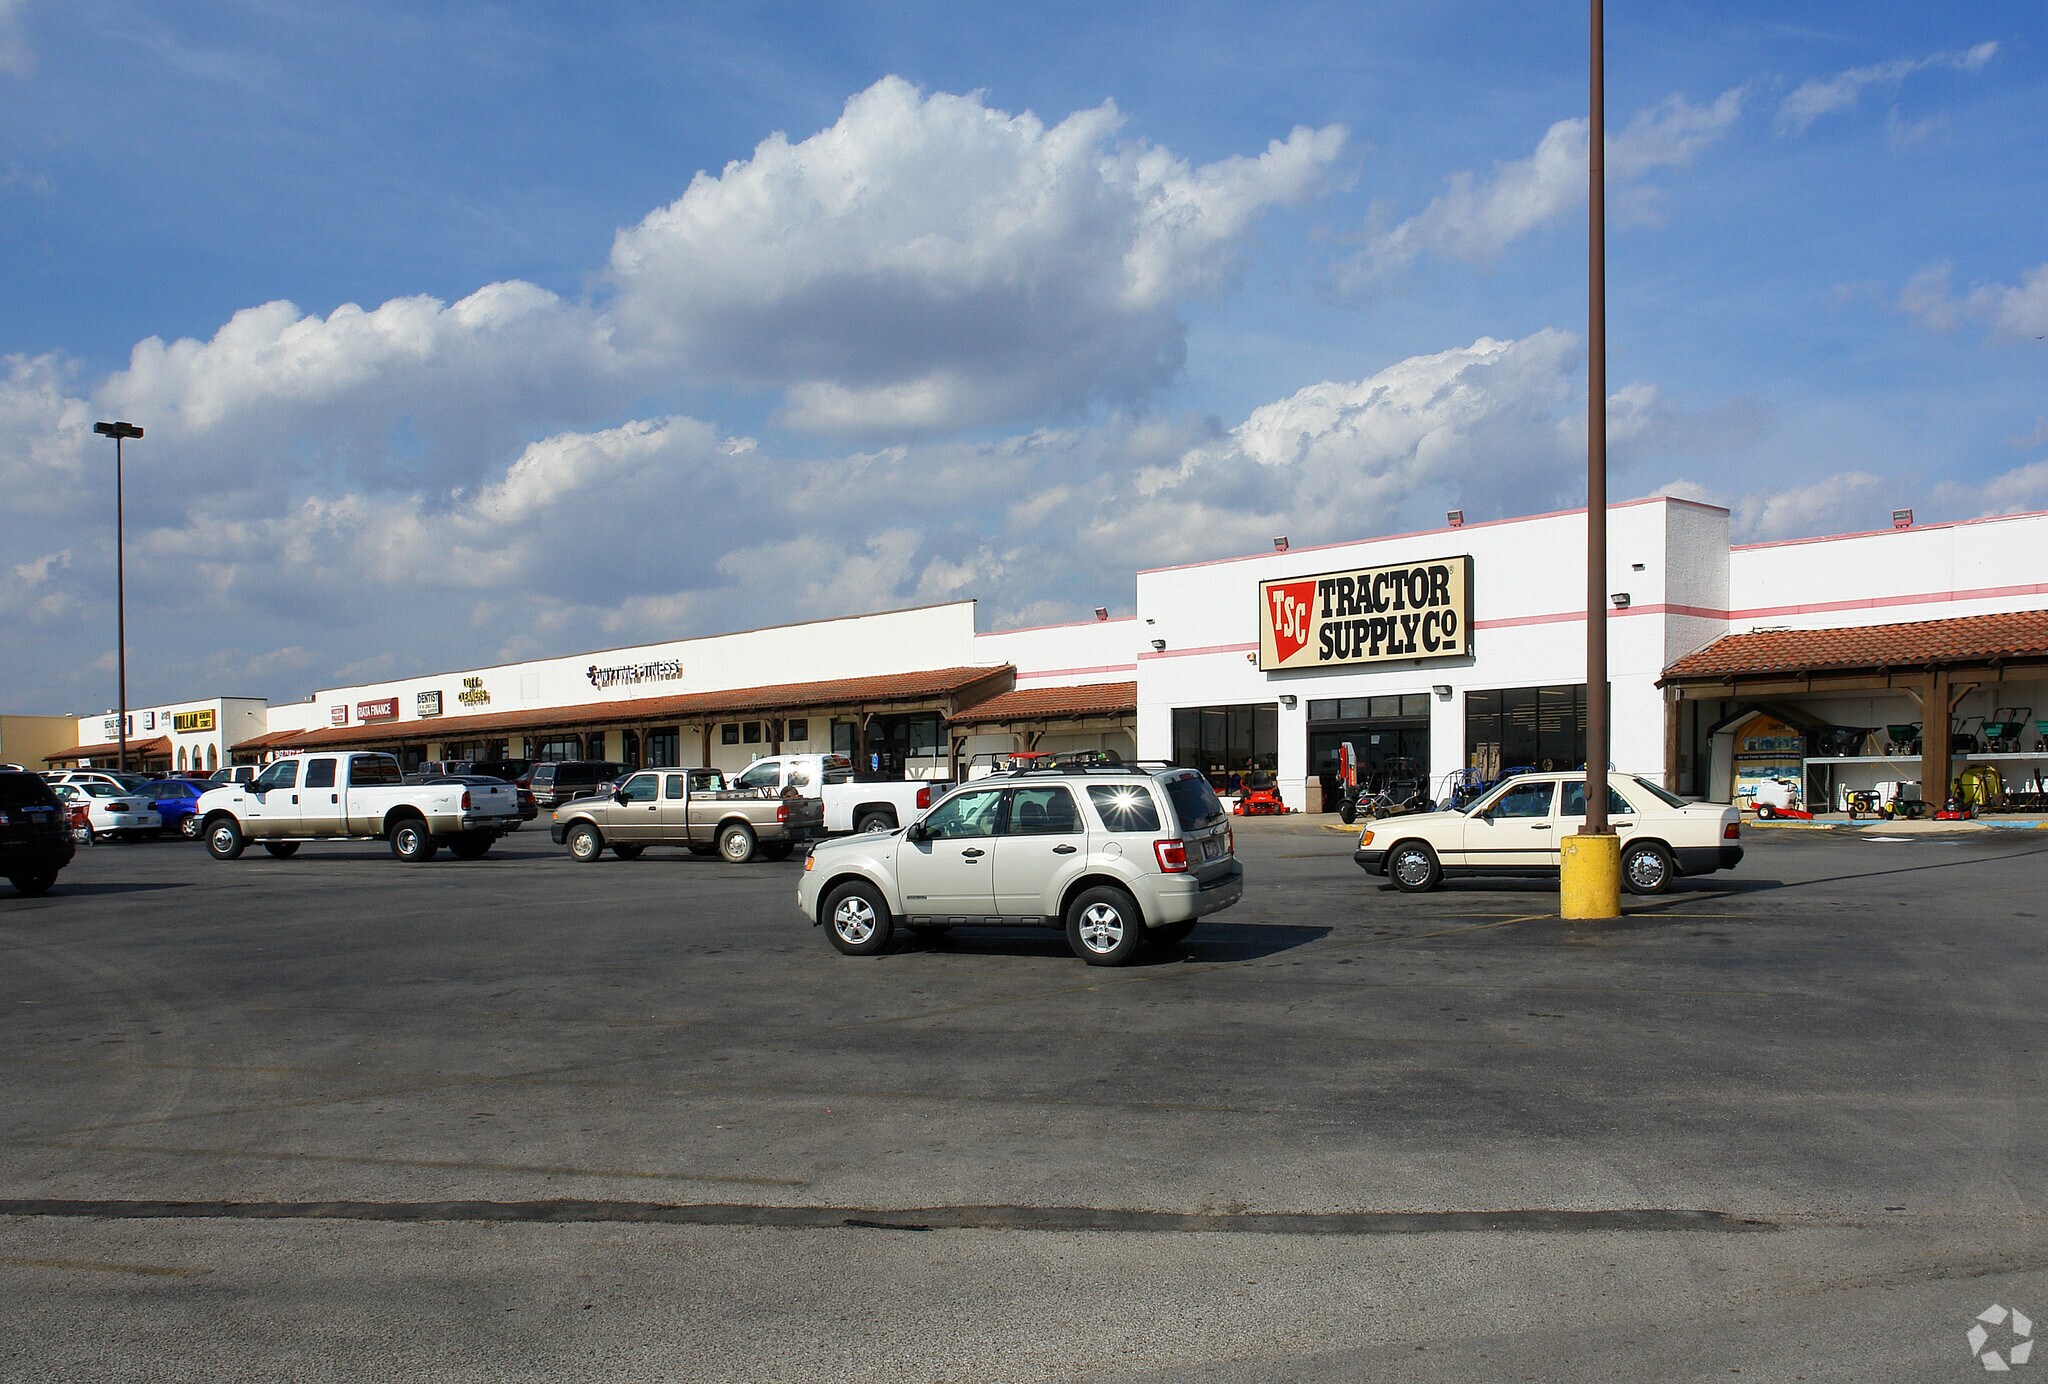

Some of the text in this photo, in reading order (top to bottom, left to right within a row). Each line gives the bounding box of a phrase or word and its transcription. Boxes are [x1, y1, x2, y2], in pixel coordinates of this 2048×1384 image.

[1318, 564, 1450, 618] TRACTOR
[1272, 590, 1306, 645] TSC
[1319, 613, 1421, 661] SUPPLY
[370, 702, 391, 716] FINANCE
[418, 692, 438, 704] DENTIST
[174, 714, 198, 730] DOLLAR
